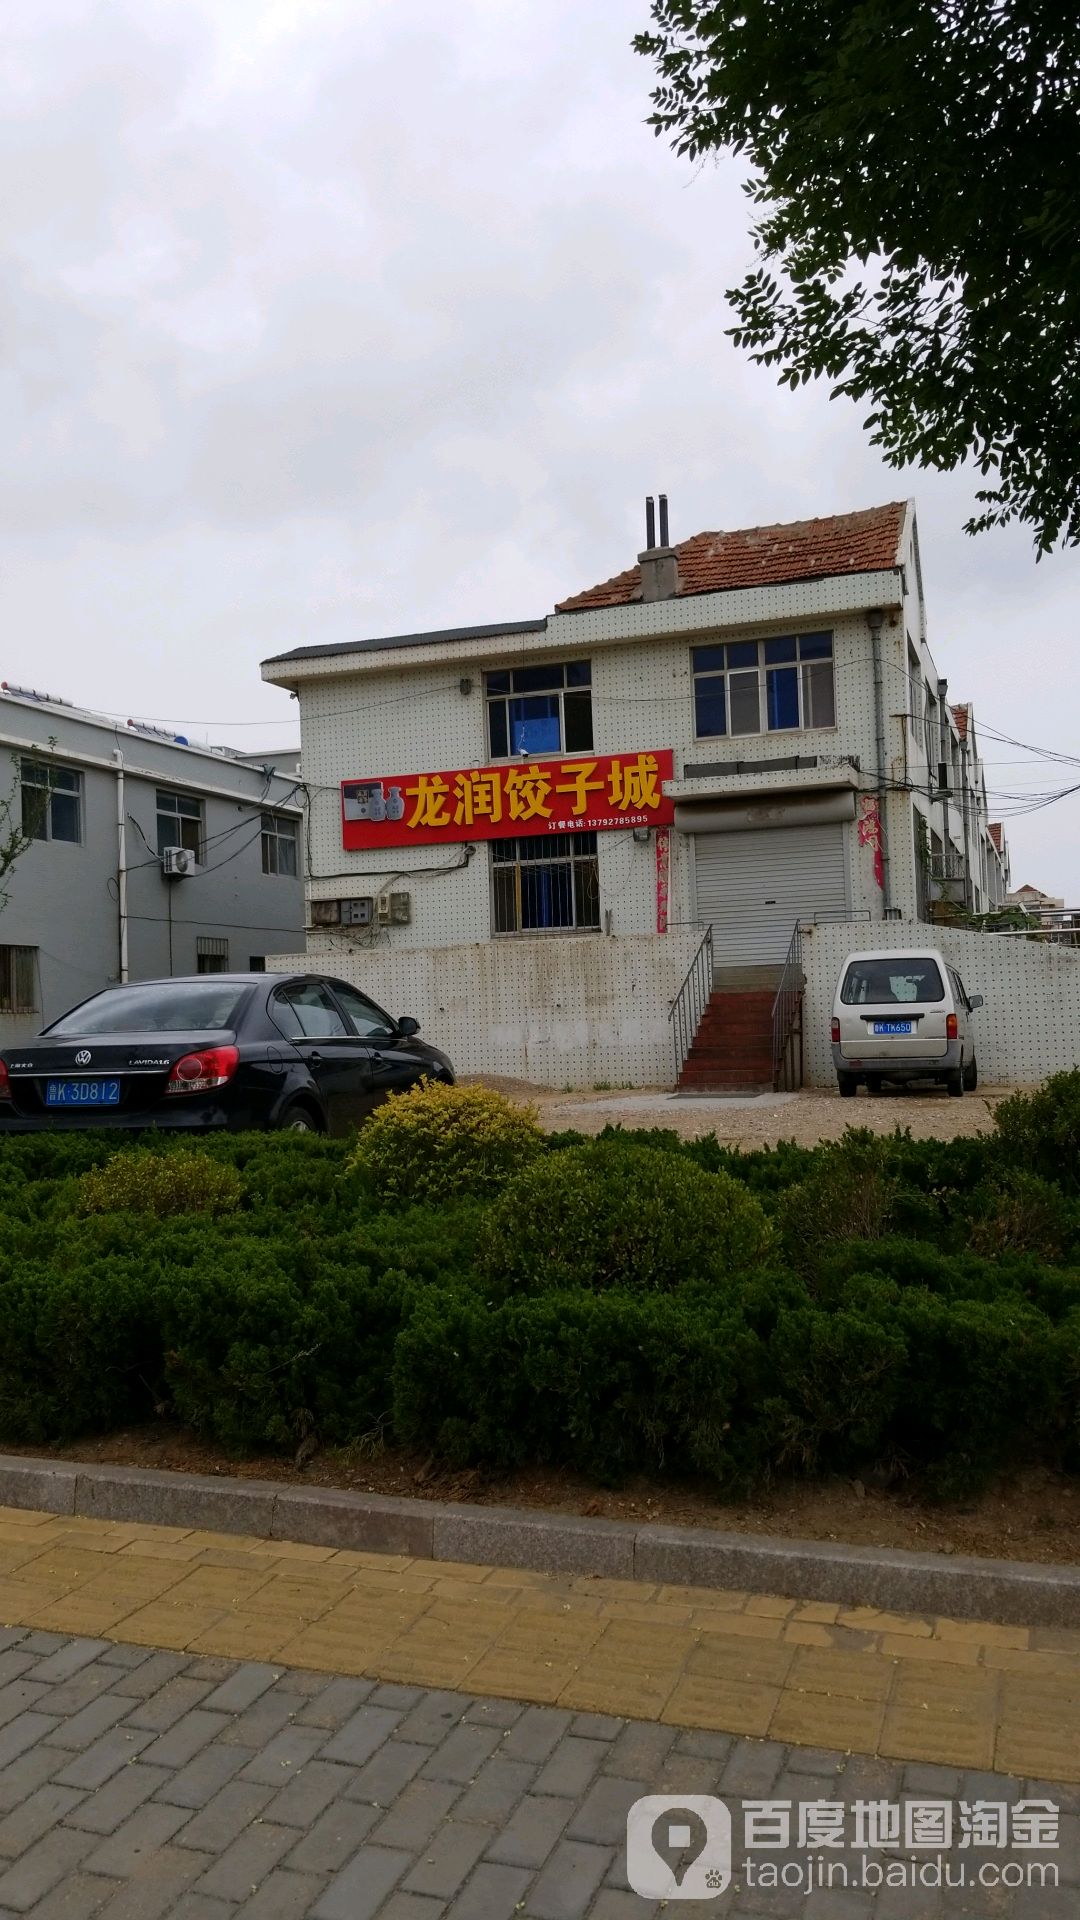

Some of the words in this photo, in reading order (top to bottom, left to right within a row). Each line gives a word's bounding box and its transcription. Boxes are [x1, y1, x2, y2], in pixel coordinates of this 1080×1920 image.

[406, 754, 661, 829] 龙润饺子城
